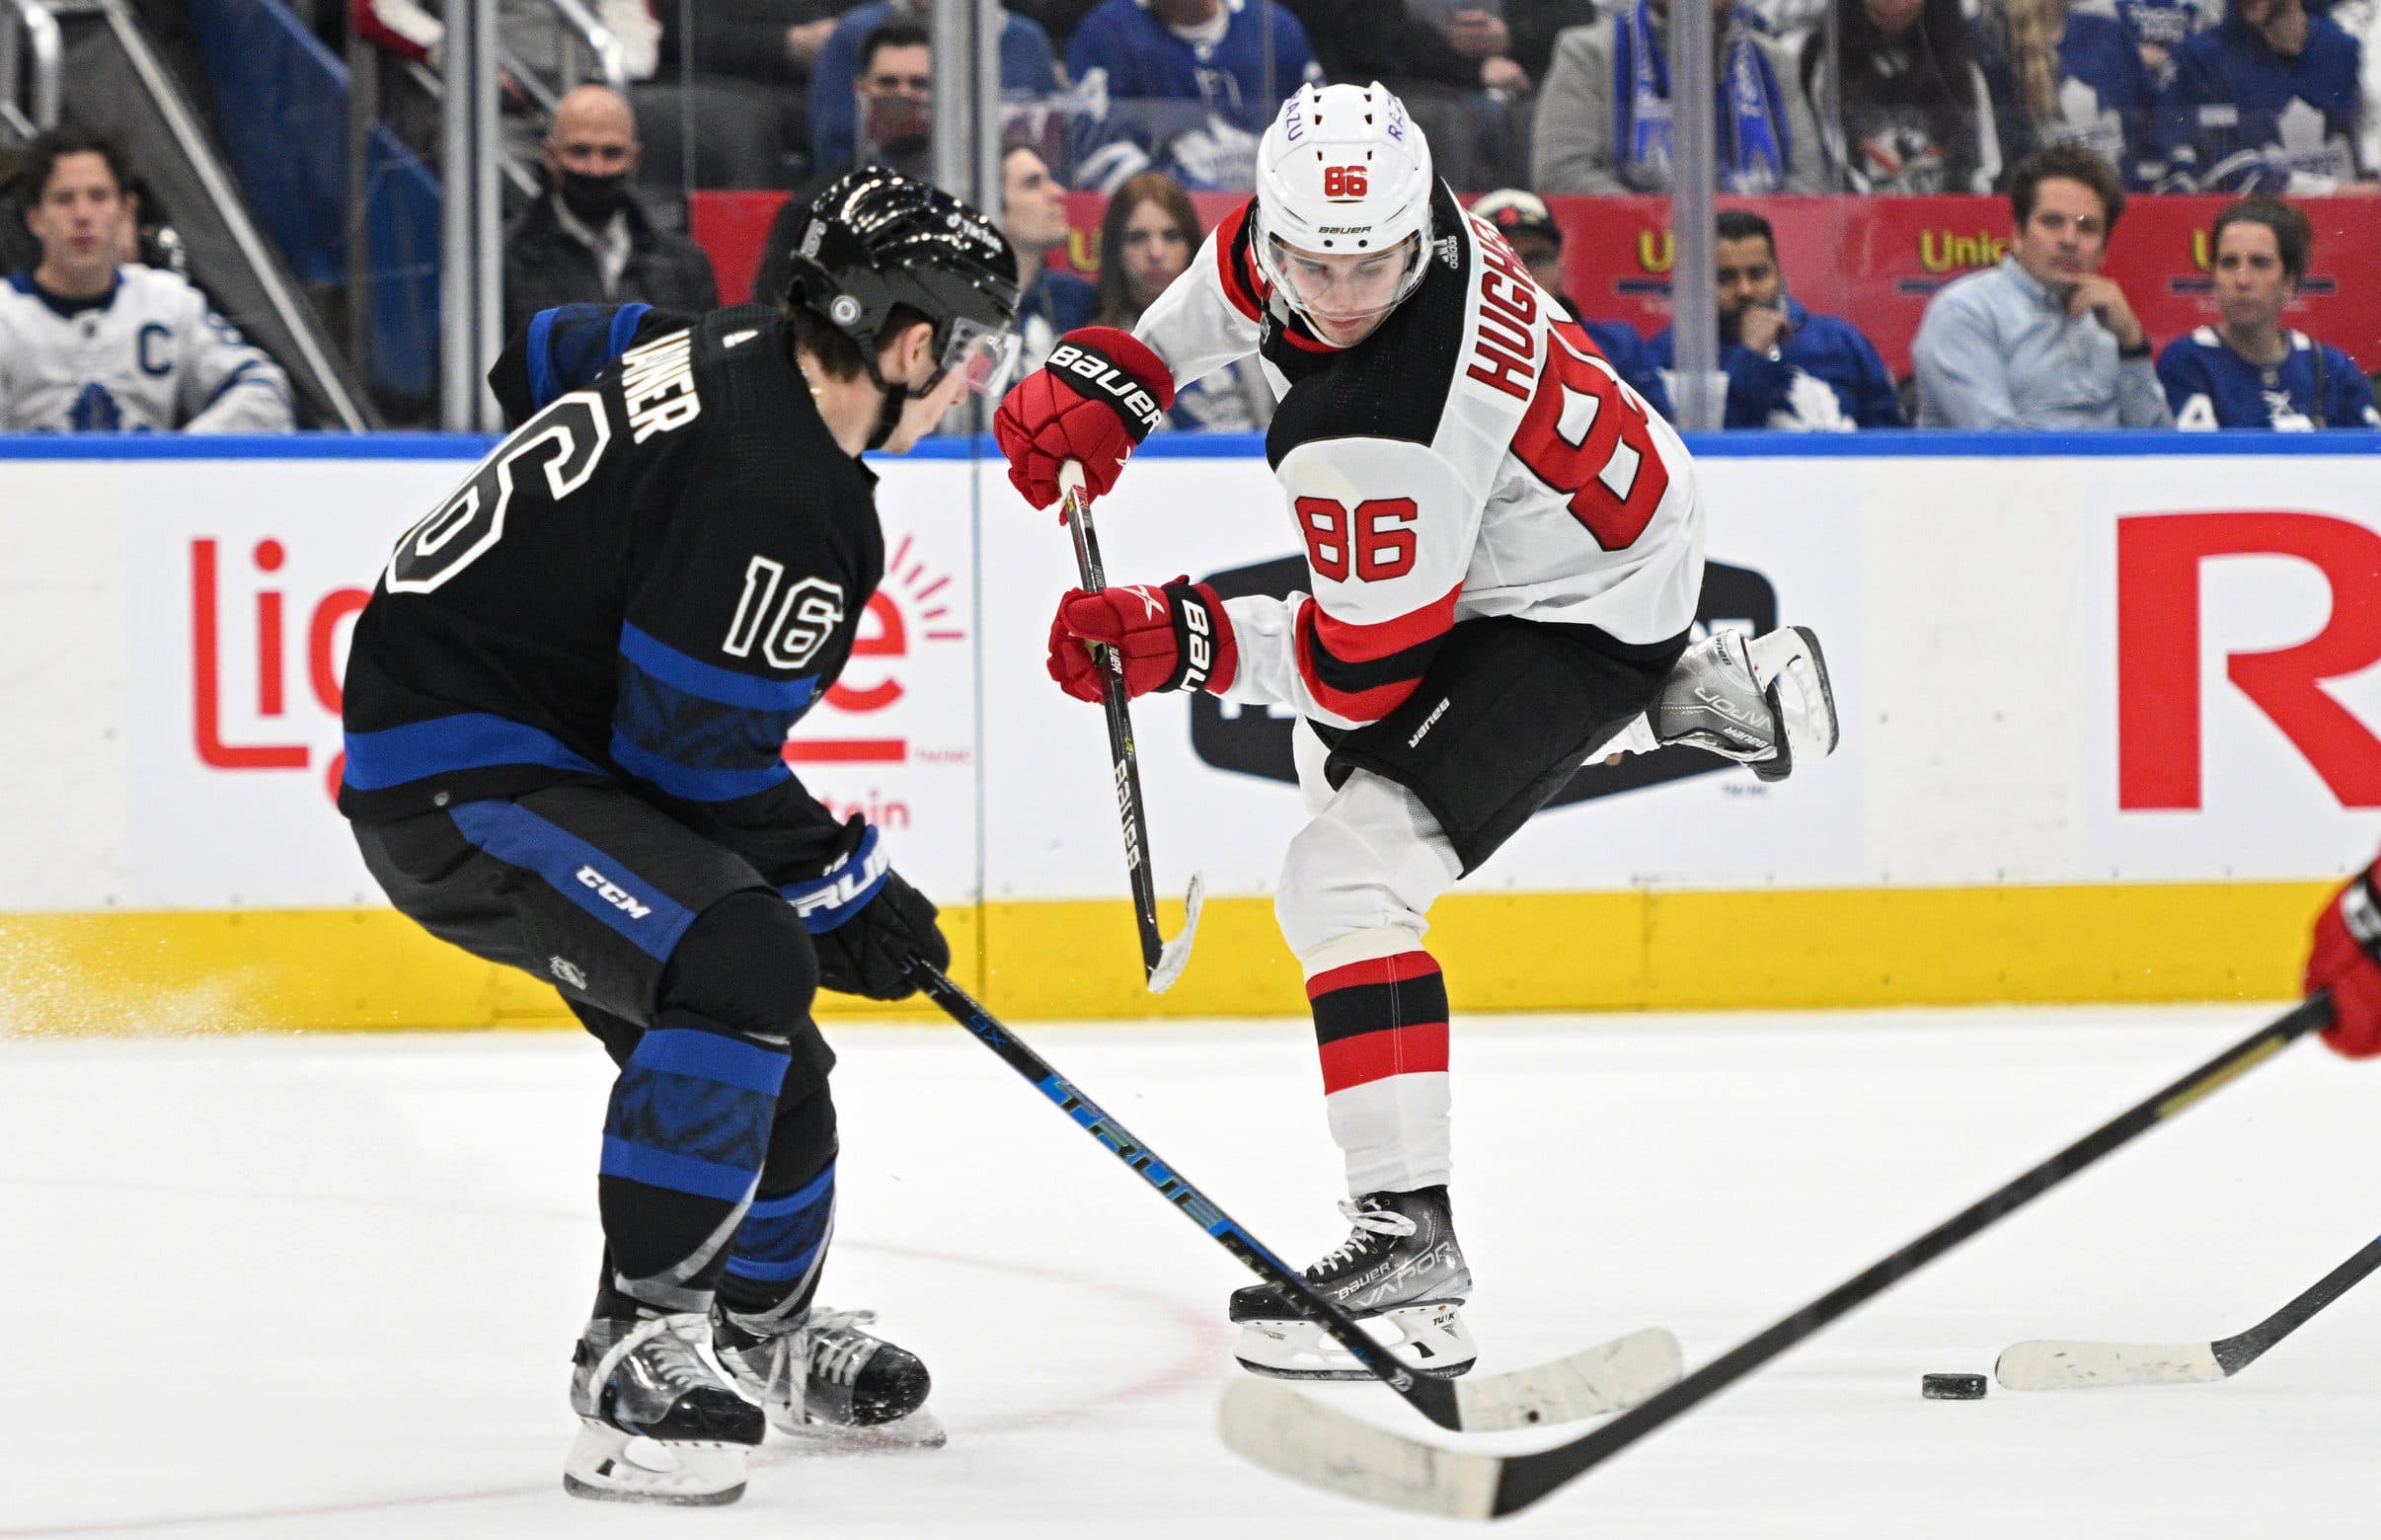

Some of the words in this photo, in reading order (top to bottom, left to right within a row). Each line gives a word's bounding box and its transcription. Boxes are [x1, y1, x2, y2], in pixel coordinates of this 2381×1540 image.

[1325, 166, 1368, 197] 86
[1318, 226, 1373, 235] BAUER
[1447, 235, 1459, 270] adidas
[1919, 229, 2011, 271] Unic
[136, 322, 172, 376] C
[1047, 346, 1163, 434] BAUER
[1293, 495, 1419, 584] 86
[722, 554, 844, 669] 16
[1180, 598, 1211, 694] BAU
[1407, 696, 1451, 749] BAUER
[1724, 726, 1769, 748] BAUER
[821, 789, 910, 829] tein
[1114, 759, 1141, 871] BAUER
[576, 865, 653, 920] CCM
[1054, 1080, 1226, 1233] TRUE
[1338, 1262, 1391, 1300] BAUER
[1354, 1242, 1453, 1307] VAPOR
